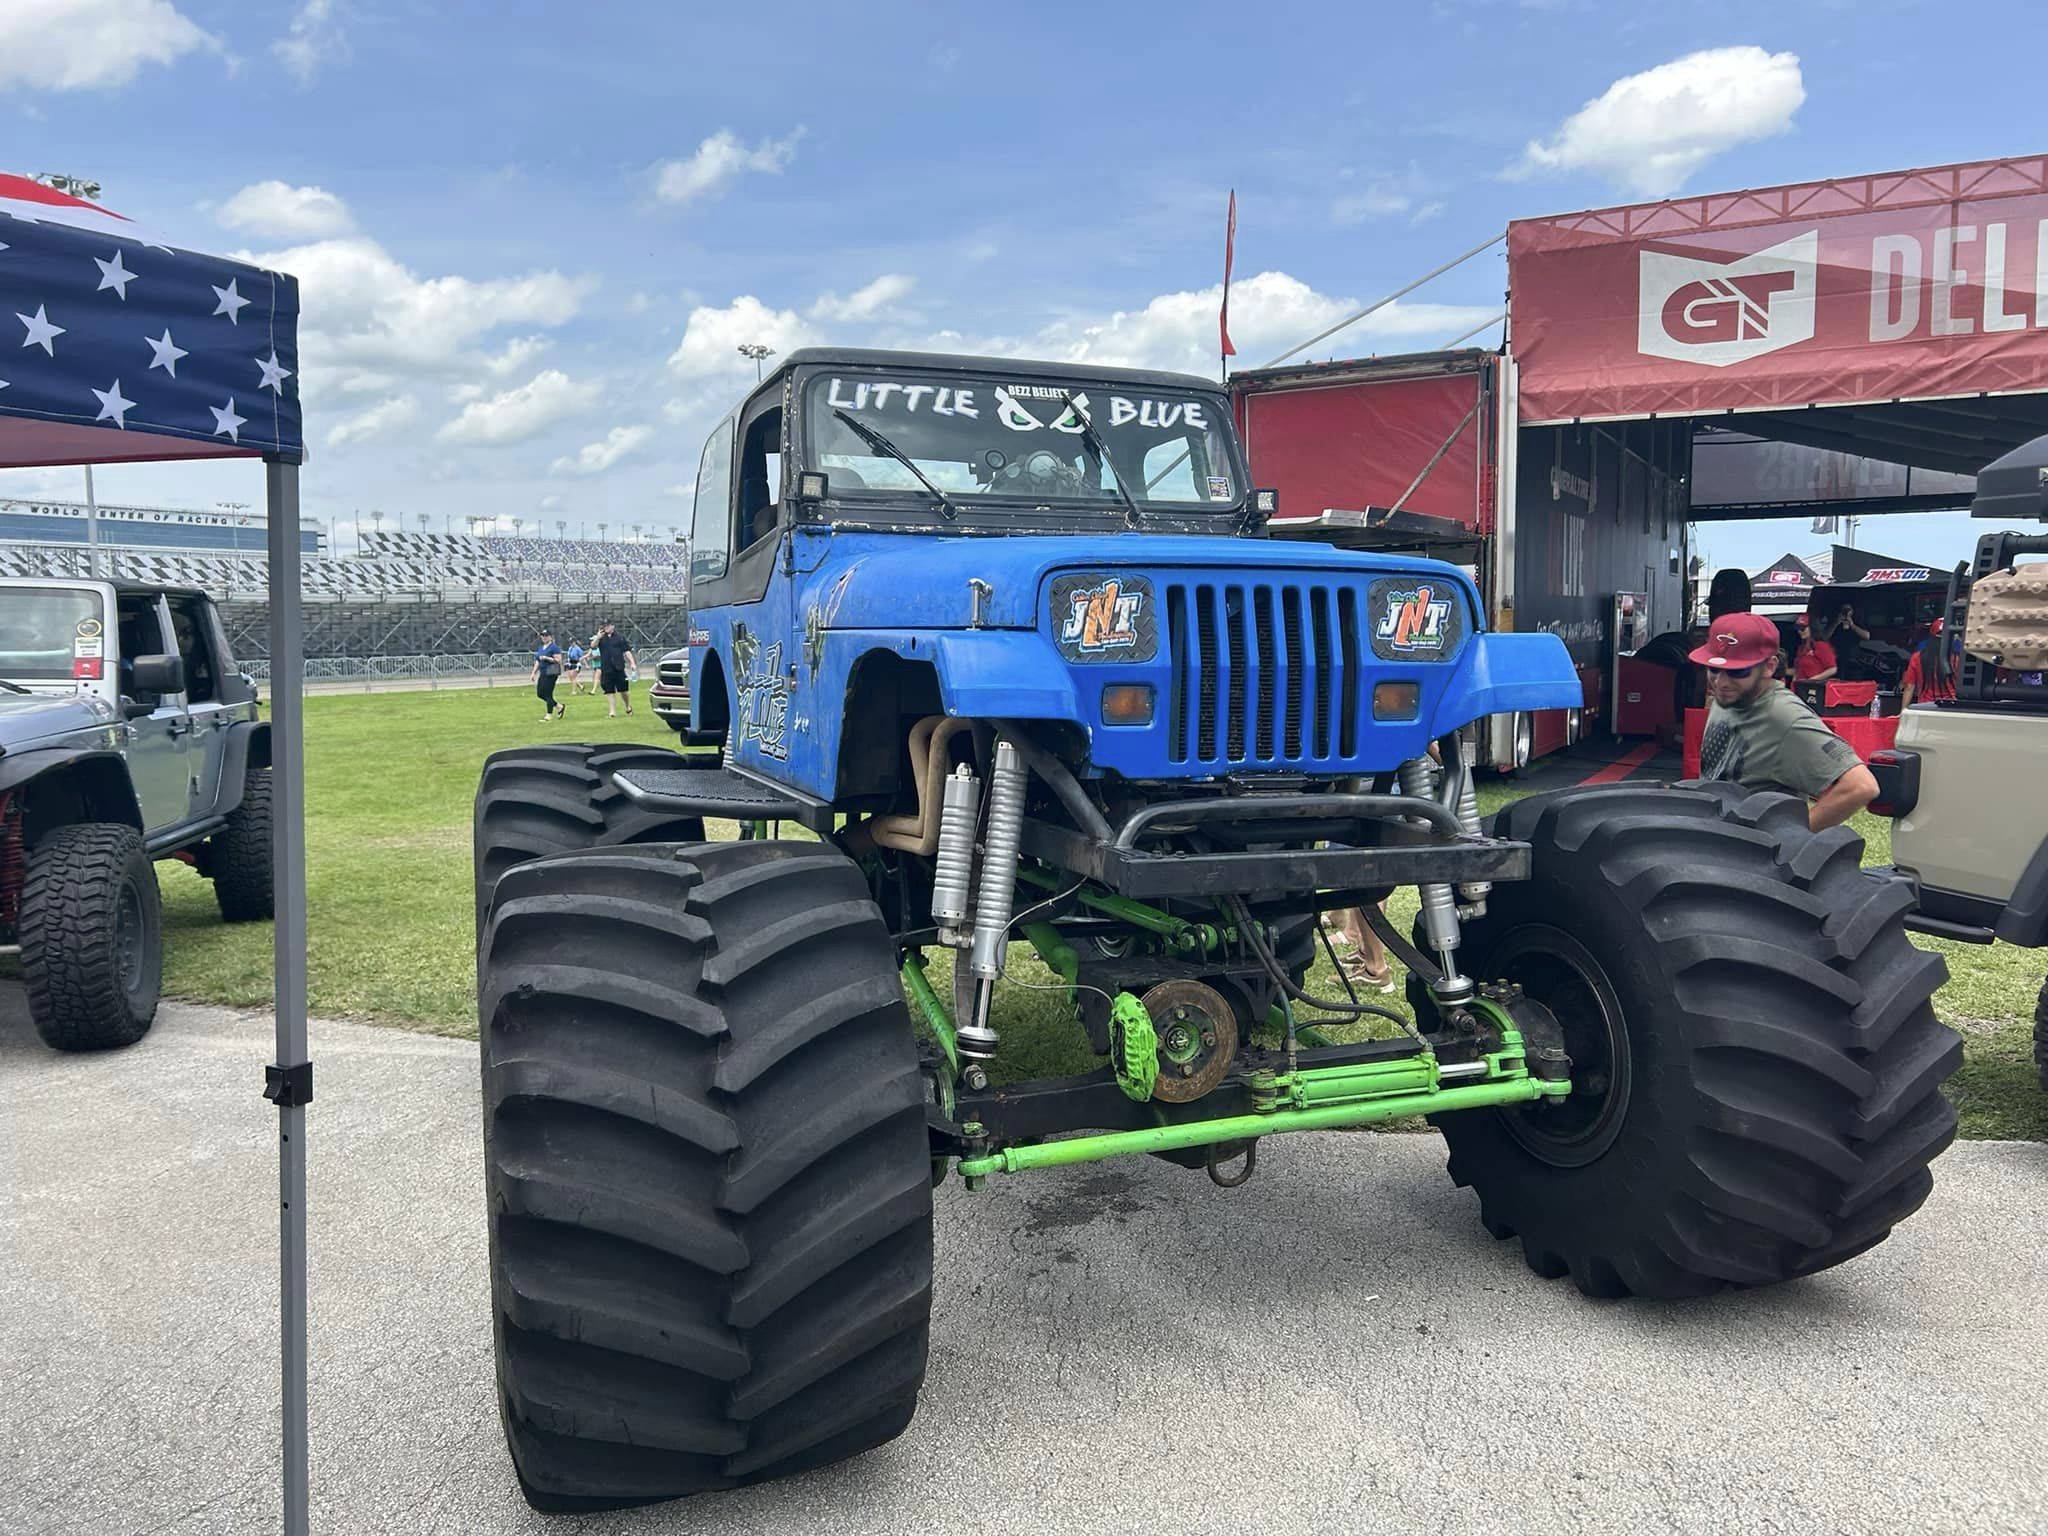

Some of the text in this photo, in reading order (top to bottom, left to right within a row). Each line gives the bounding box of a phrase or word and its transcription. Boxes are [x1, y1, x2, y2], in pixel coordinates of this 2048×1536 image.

[827, 378, 1208, 431] LITTLE BLUE
[1007, 384, 1031, 397] BEZZ
[31, 506, 80, 516] WORLD
[99, 510, 144, 520] ENTER
[177, 515, 227, 525] RACING
[1865, 569, 1928, 581] AMSOIL
[1065, 582, 1139, 647] JNT
[1380, 588, 1448, 646] JNT
